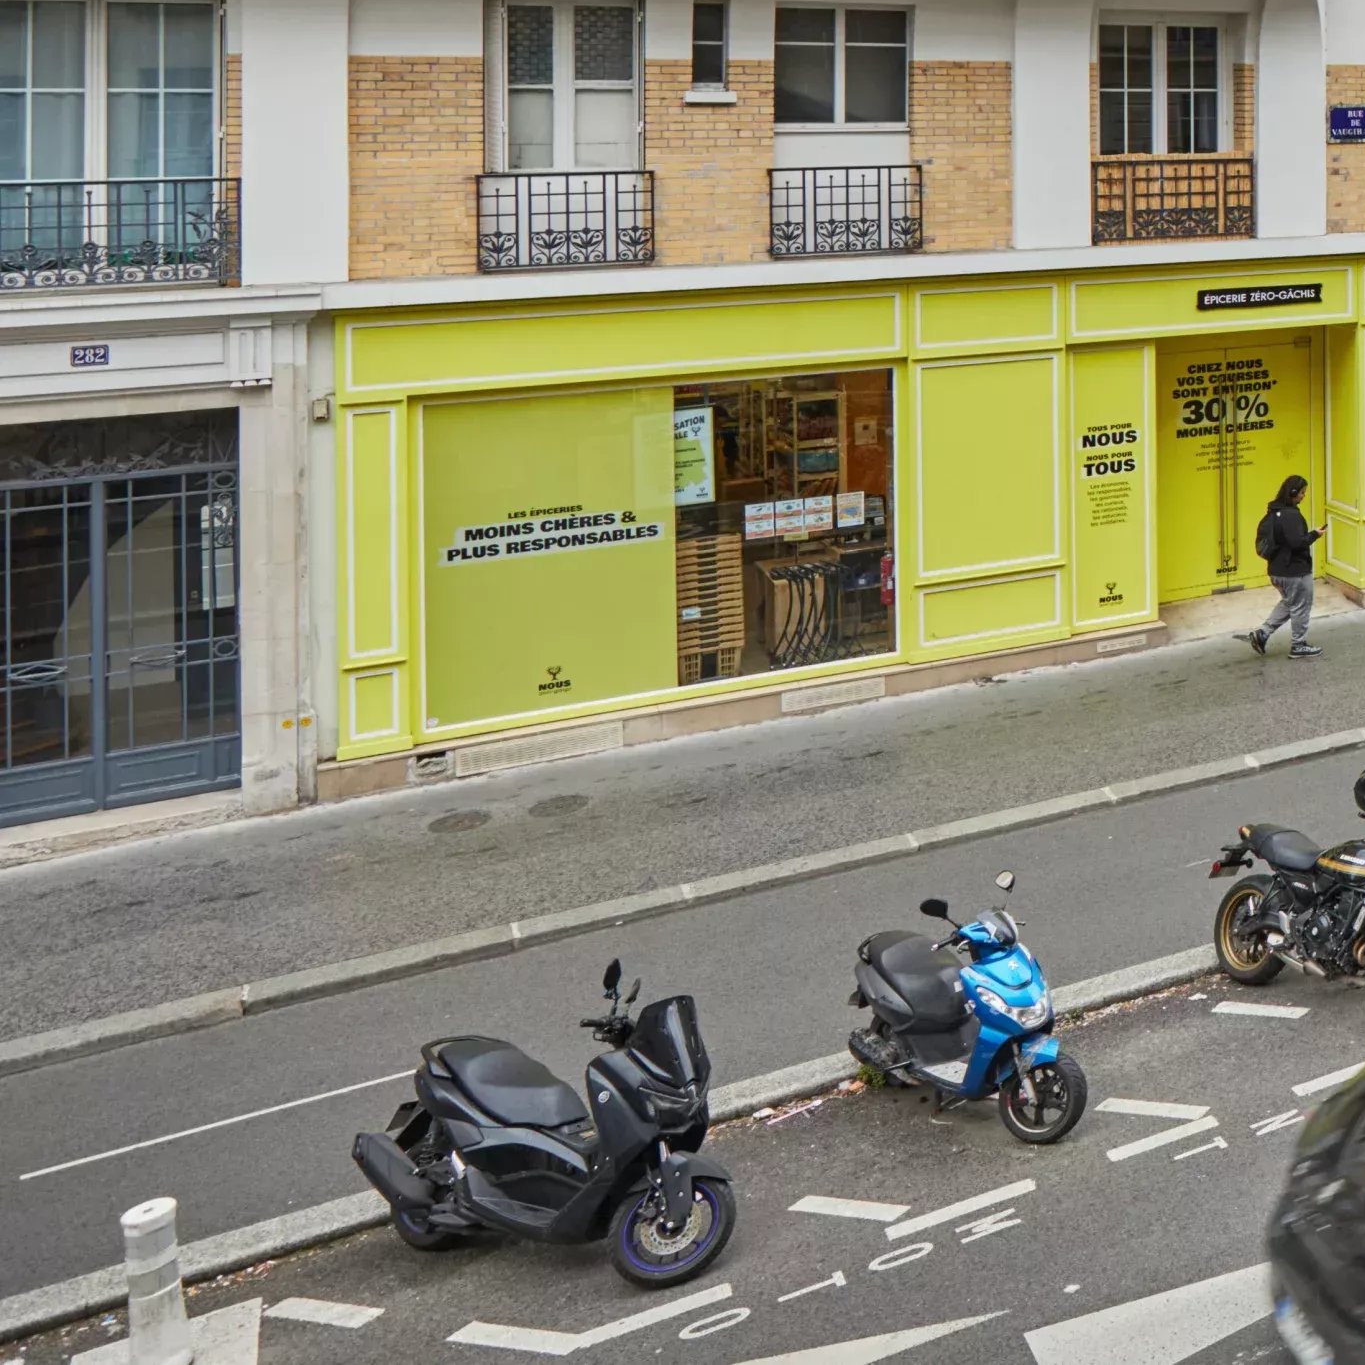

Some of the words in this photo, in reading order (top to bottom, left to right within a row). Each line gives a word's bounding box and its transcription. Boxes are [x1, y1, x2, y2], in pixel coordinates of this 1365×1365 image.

[1347, 110, 1364, 118] RUE
[1350, 119, 1361, 127] DE
[1204, 293, 1247, 305] ÉPICERIE
[1249, 289, 1315, 302] ZÉRO-GÂCHIS
[74, 347, 105, 364] 282
[1187, 362, 1222, 374] CHEZ
[1225, 358, 1263, 371] NOUS
[1177, 375, 1205, 387] VOS
[1208, 369, 1270, 384] COURSES
[1172, 387, 1209, 399] SONT
[1182, 397, 1227, 425] 30
[1235, 393, 1269, 420] %
[1110, 422, 1132, 430] POUR
[1176, 425, 1220, 439] MOINS
[1226, 419, 1274, 433] CHÈRES
[1082, 430, 1138, 448] NOUS
[1083, 459, 1136, 477] TOUS
[530, 504, 583, 516] ÉPICERIES
[464, 522, 534, 541] MOINS
[540, 514, 616, 533] CHÈRES
[621, 511, 637, 523] &
[447, 544, 500, 562] PLUS
[506, 525, 659, 554] RESPONSABLES
[1216, 566, 1237, 574] NOUS
[1099, 594, 1124, 604] NOUS
[538, 679, 571, 691] NOUS
